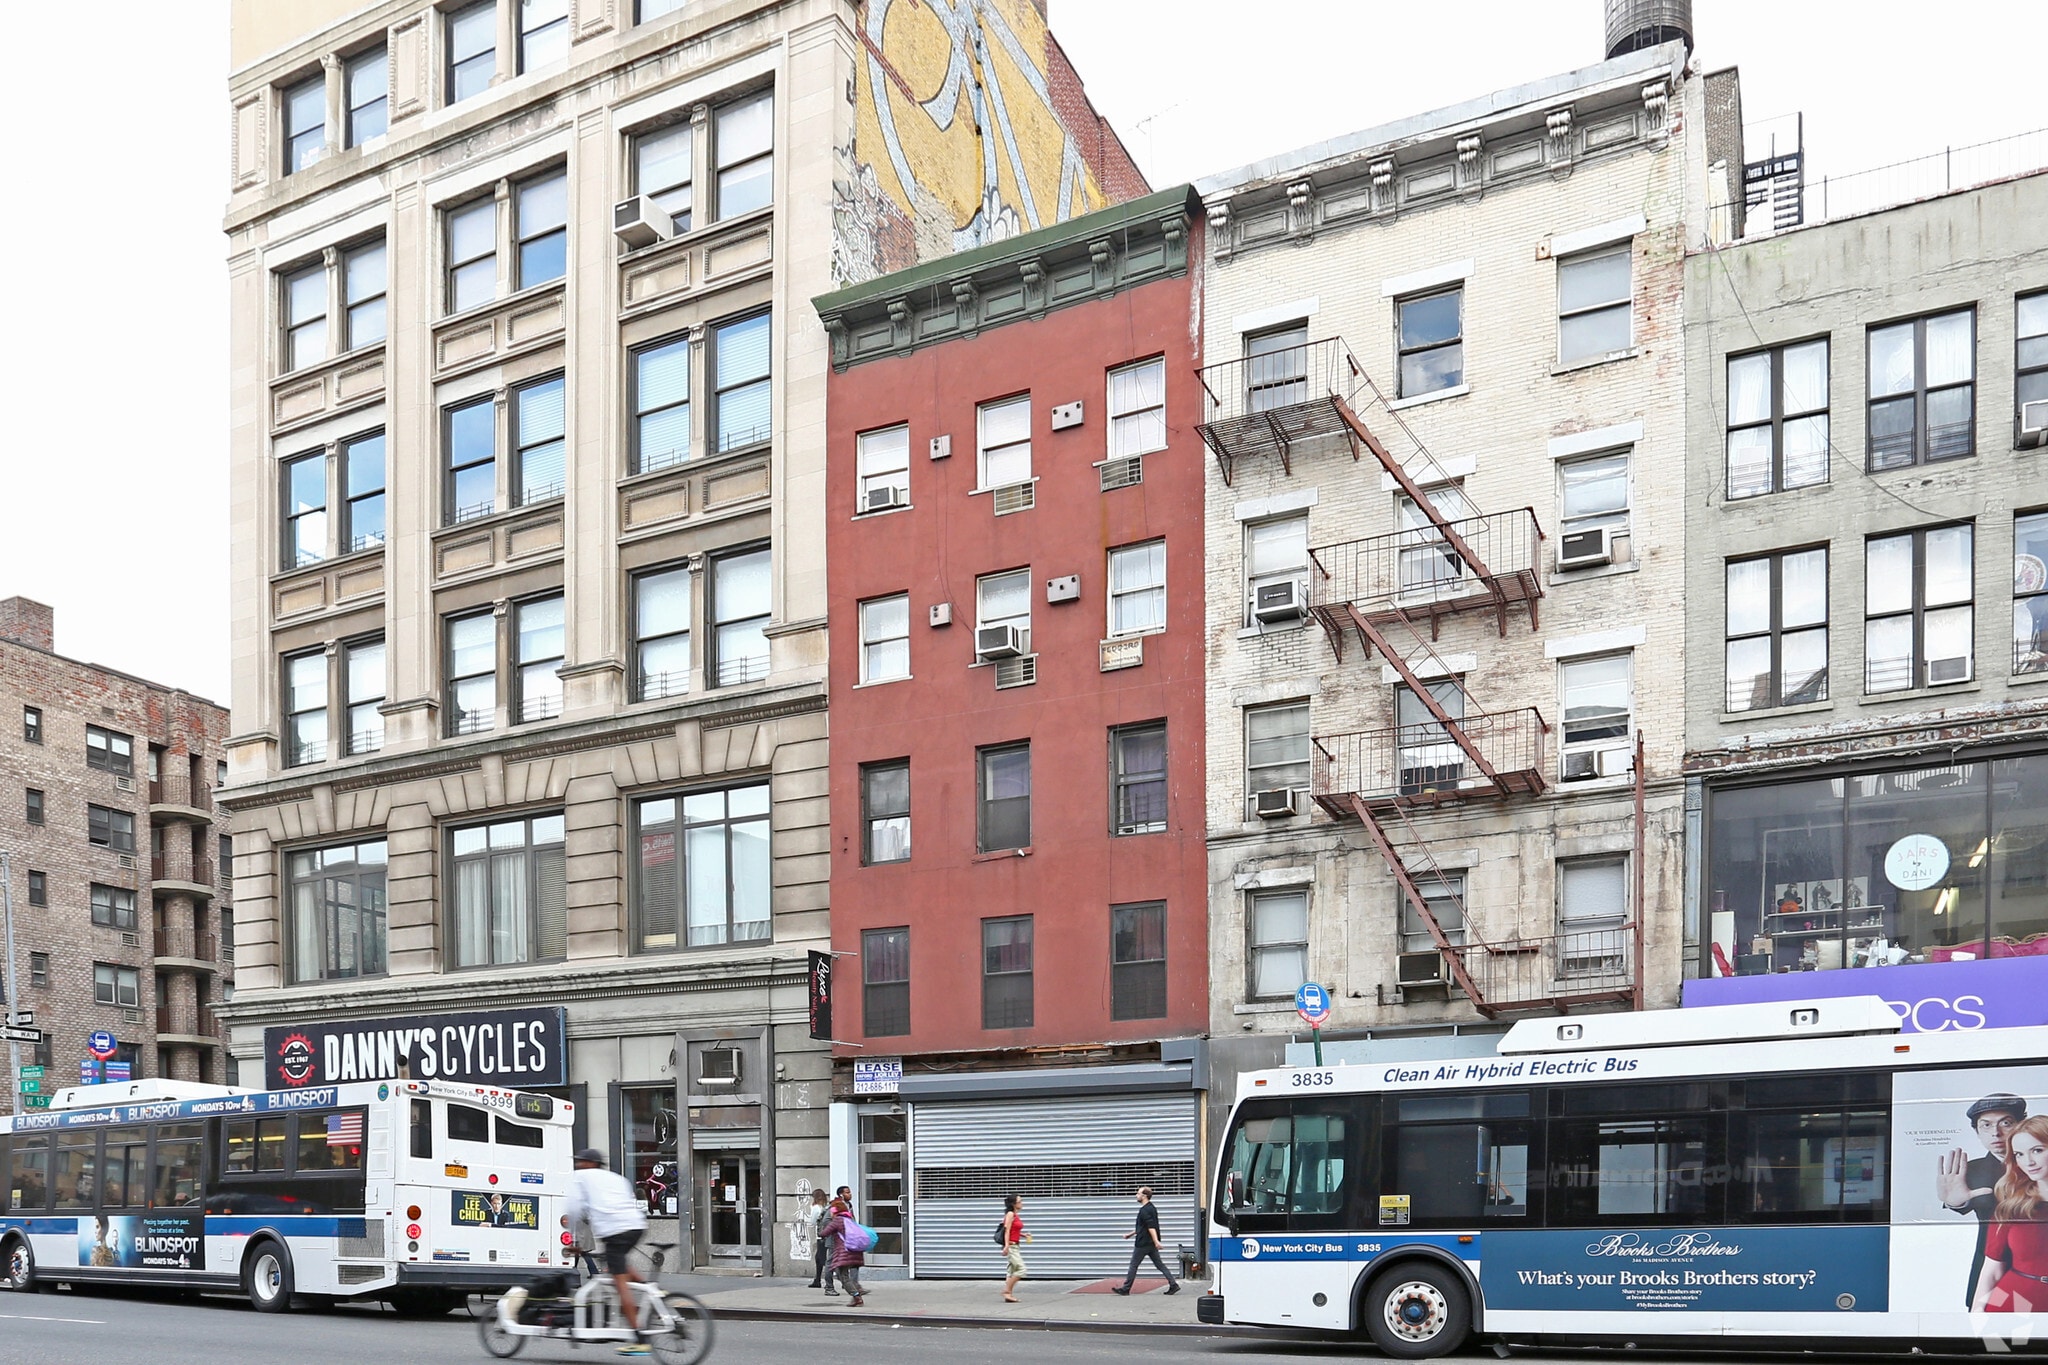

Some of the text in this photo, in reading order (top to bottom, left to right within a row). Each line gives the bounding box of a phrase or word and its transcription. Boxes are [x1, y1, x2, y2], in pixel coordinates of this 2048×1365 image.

[1902, 868, 1932, 879] DANI
[324, 1020, 546, 1081] DANNY'S CYCLES
[856, 1063, 900, 1073] LEASE
[1383, 1057, 1639, 1083] Clean Air Hybrid Electric Bus
[1292, 1072, 1334, 1087] 3835
[268, 1089, 334, 1109] BLINDSPOT
[457, 1089, 468, 1097] City
[26, 1096, 33, 1105] W
[37, 1097, 45, 1106] 15
[192, 1101, 224, 1113] MONDAYS
[482, 1095, 513, 1109] 6399
[527, 1101, 541, 1112] M5
[129, 1103, 182, 1120] BLINDSPOT
[16, 1114, 61, 1129] BLINDSPOT
[69, 1114, 96, 1124] MONDAYS
[464, 1199, 480, 1210] LEE
[509, 1202, 532, 1214] MAKE
[459, 1209, 486, 1221] CHILD
[514, 1213, 526, 1223] ME
[135, 1236, 199, 1253] BLINDSPOT
[1241, 1243, 1381, 1254] MTA New York City Bus 3835
[1585, 1232, 1743, 1257] Brooks Brothers
[143, 1257, 166, 1265] MONDAYS
[1517, 1269, 1817, 1290] What's your Brooks Brothers story?
